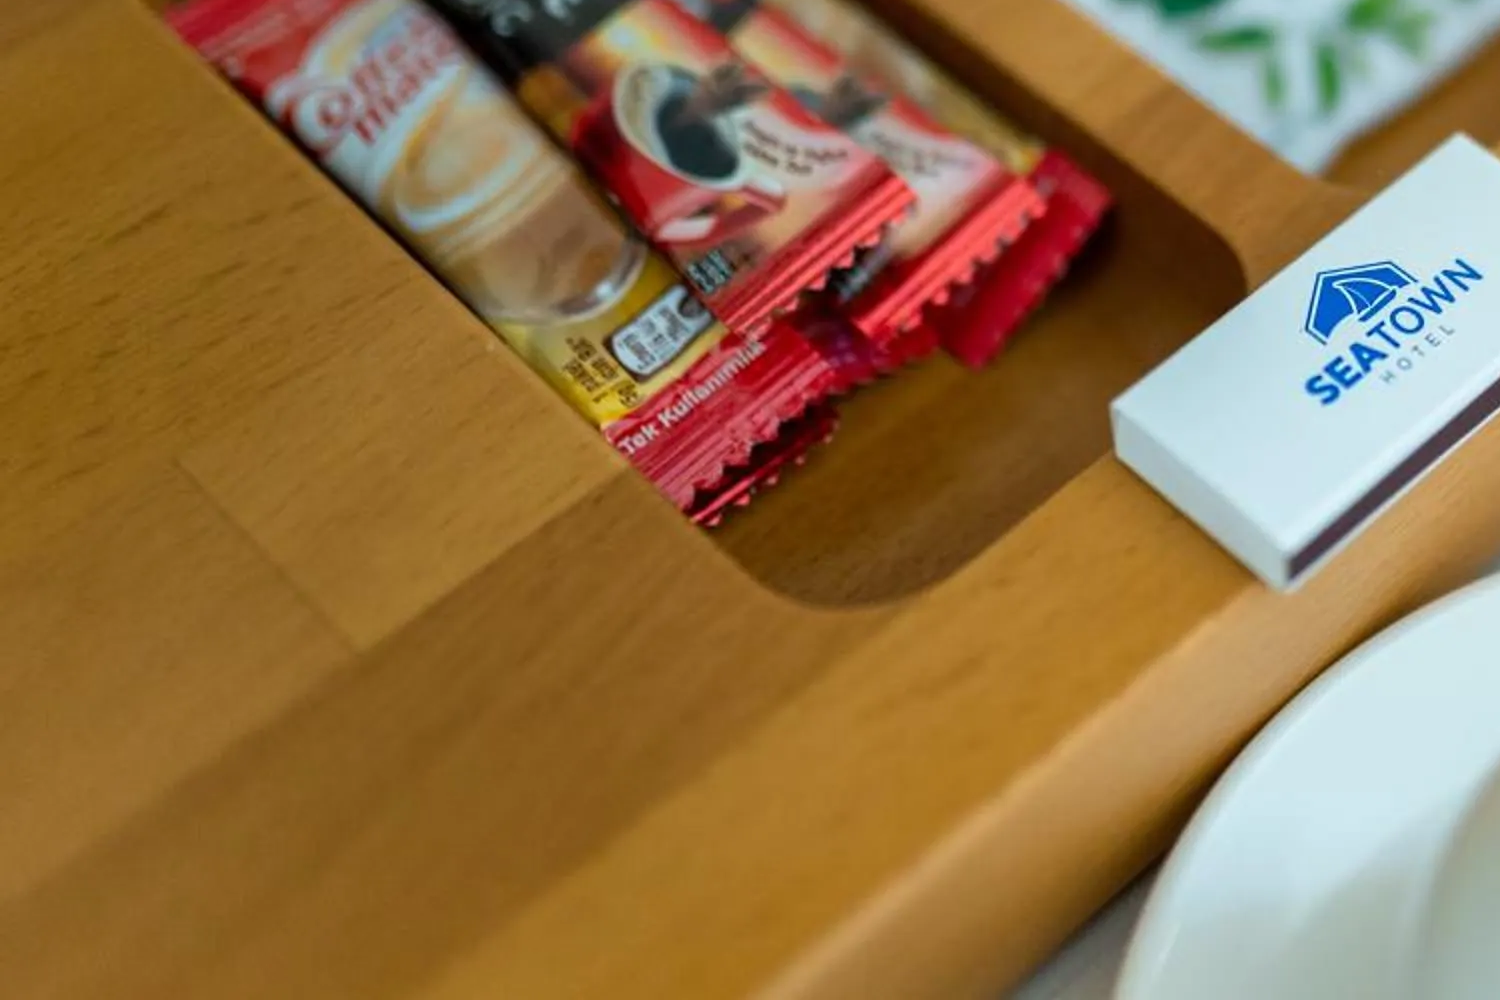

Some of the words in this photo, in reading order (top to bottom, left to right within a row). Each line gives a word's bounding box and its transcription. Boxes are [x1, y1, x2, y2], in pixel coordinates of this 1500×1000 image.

[1304, 257, 1484, 406] SEATOWN
[1380, 324, 1455, 384] HOTEL
[617, 422, 661, 455] Tek
